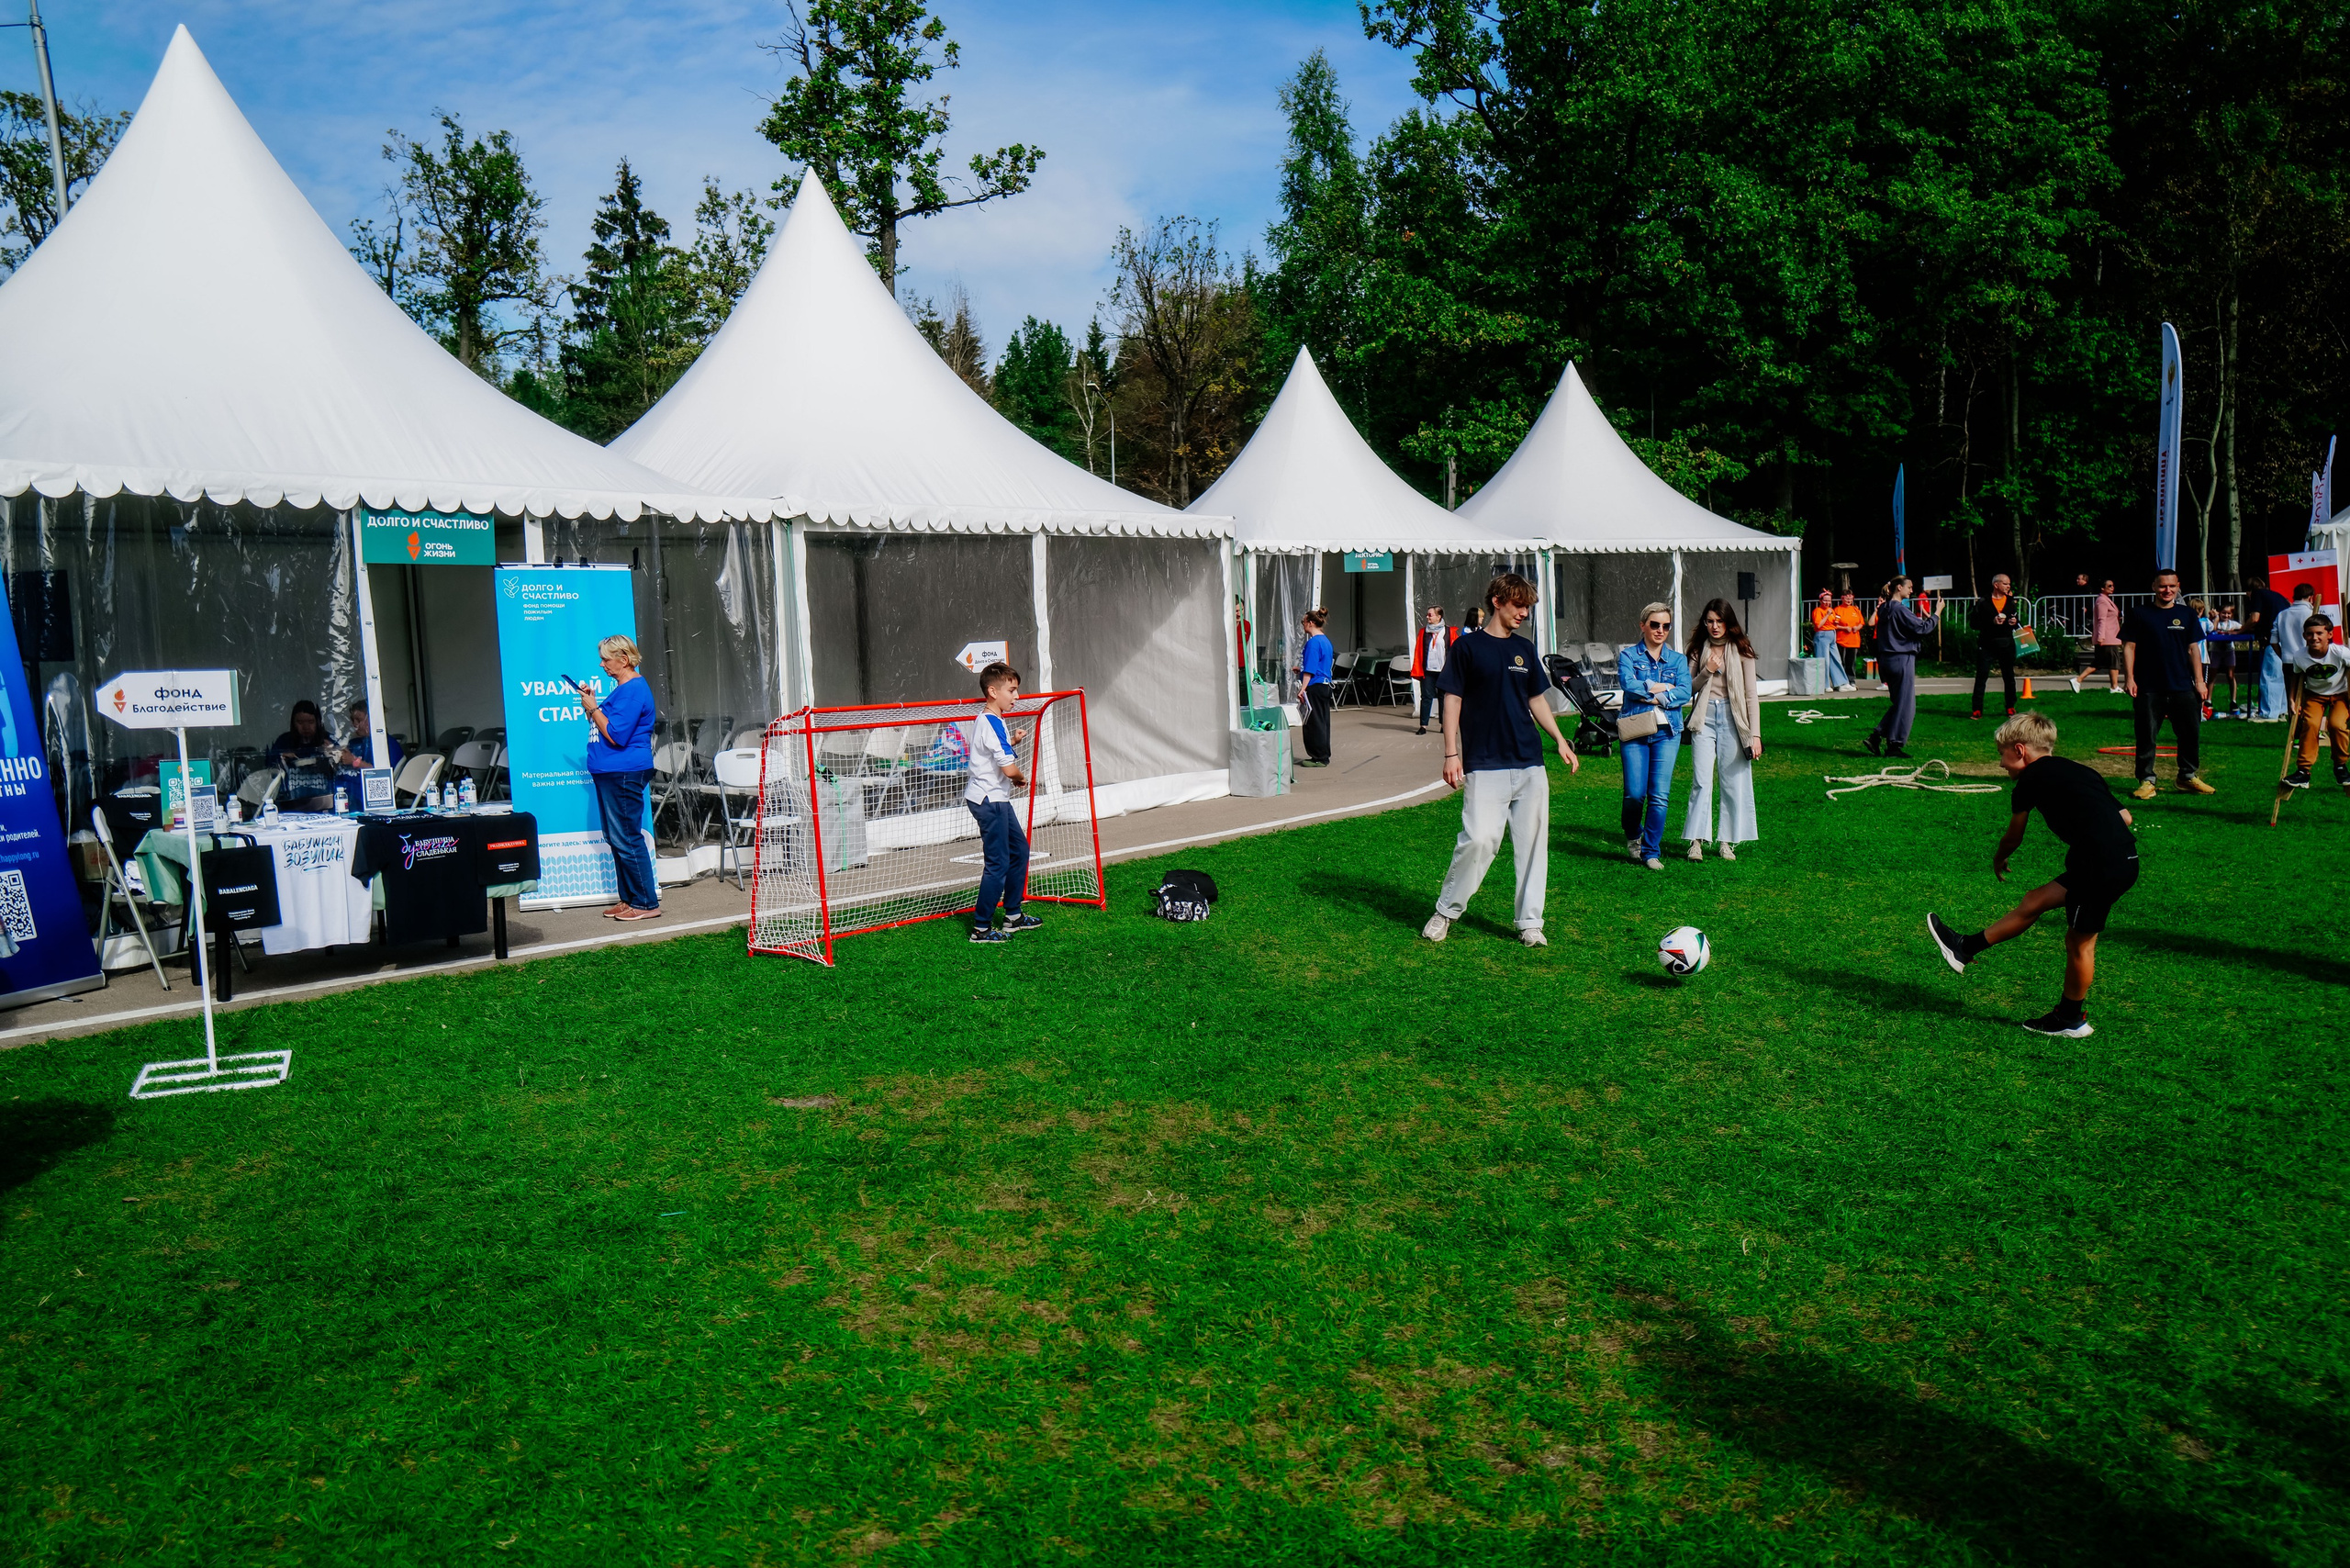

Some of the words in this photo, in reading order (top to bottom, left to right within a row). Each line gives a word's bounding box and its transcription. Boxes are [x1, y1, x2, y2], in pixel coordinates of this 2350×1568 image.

[367, 516, 409, 528] ДОЛГО
[412, 518, 420, 528] И
[422, 519, 489, 530] СЧАСТЛИВО
[424, 550, 456, 558] ЖИЗНИ
[521, 584, 554, 592] ДОЛГО
[154, 687, 203, 700] фонд
[132, 702, 227, 713] Благодействие
[539, 706, 588, 722] СТАР
[0, 756, 42, 782] ННО
[521, 770, 575, 779] Материальная
[6, 828, 41, 843] родителей.
[415, 836, 455, 847] БАБУШКИНА
[416, 846, 458, 857] СЛАДЕНЬКАЯ
[218, 884, 258, 895] BABALENCIAGA
